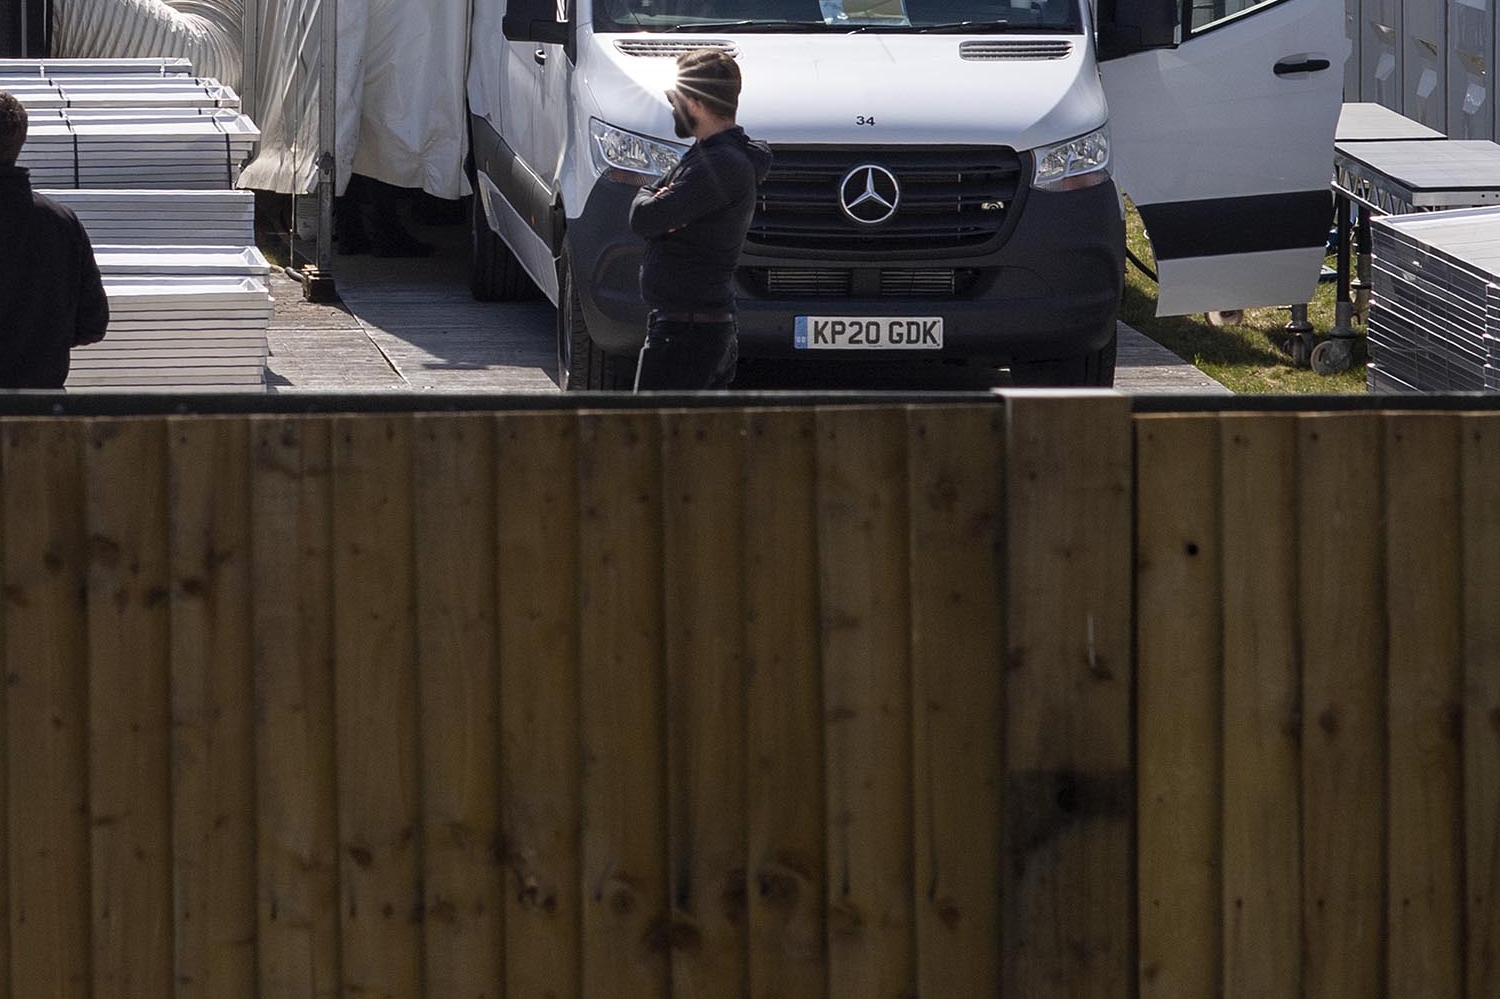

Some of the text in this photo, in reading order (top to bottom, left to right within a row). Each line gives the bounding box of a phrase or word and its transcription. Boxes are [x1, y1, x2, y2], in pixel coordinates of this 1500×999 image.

[856, 116, 875, 126] 34
[813, 320, 938, 344] KP20 GDK
